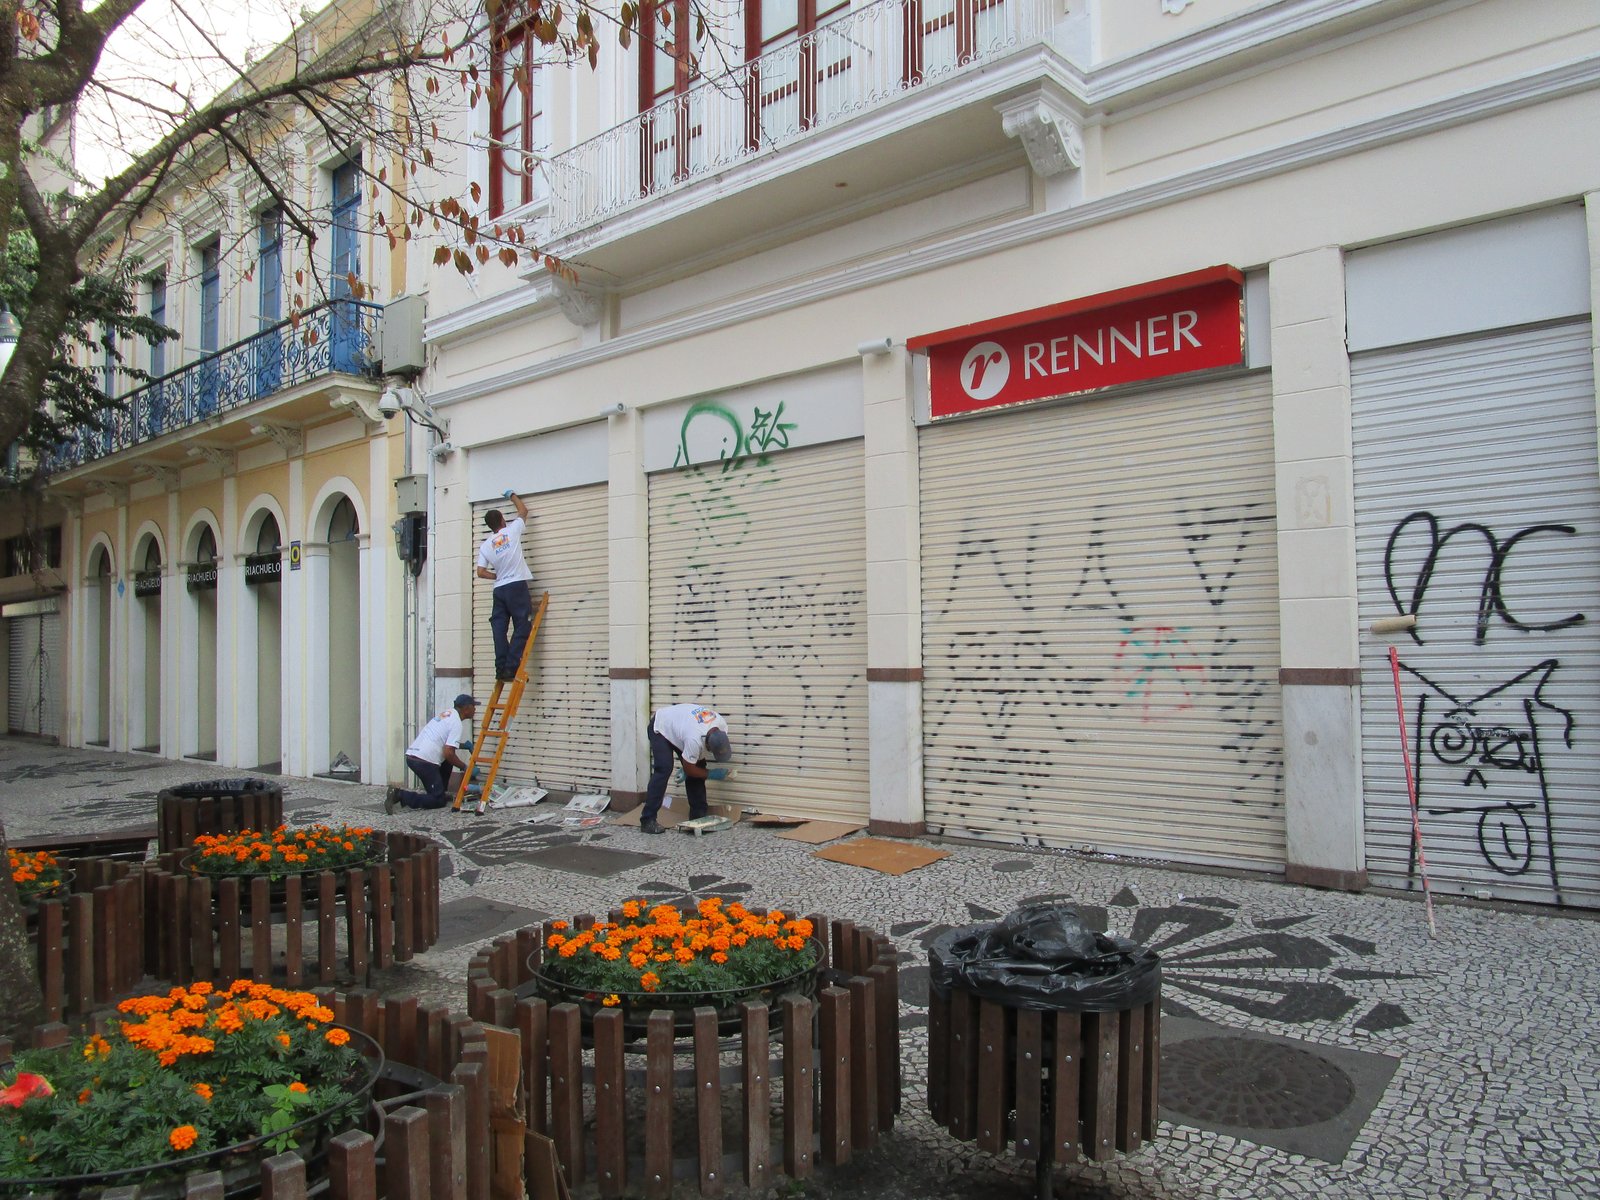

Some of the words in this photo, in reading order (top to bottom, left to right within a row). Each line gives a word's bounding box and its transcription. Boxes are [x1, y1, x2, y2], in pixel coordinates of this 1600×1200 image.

[1023, 310, 1202, 379] RENNER
[245, 562, 281, 576] RIACHUELO
[187, 570, 217, 583] RIACHUELO
